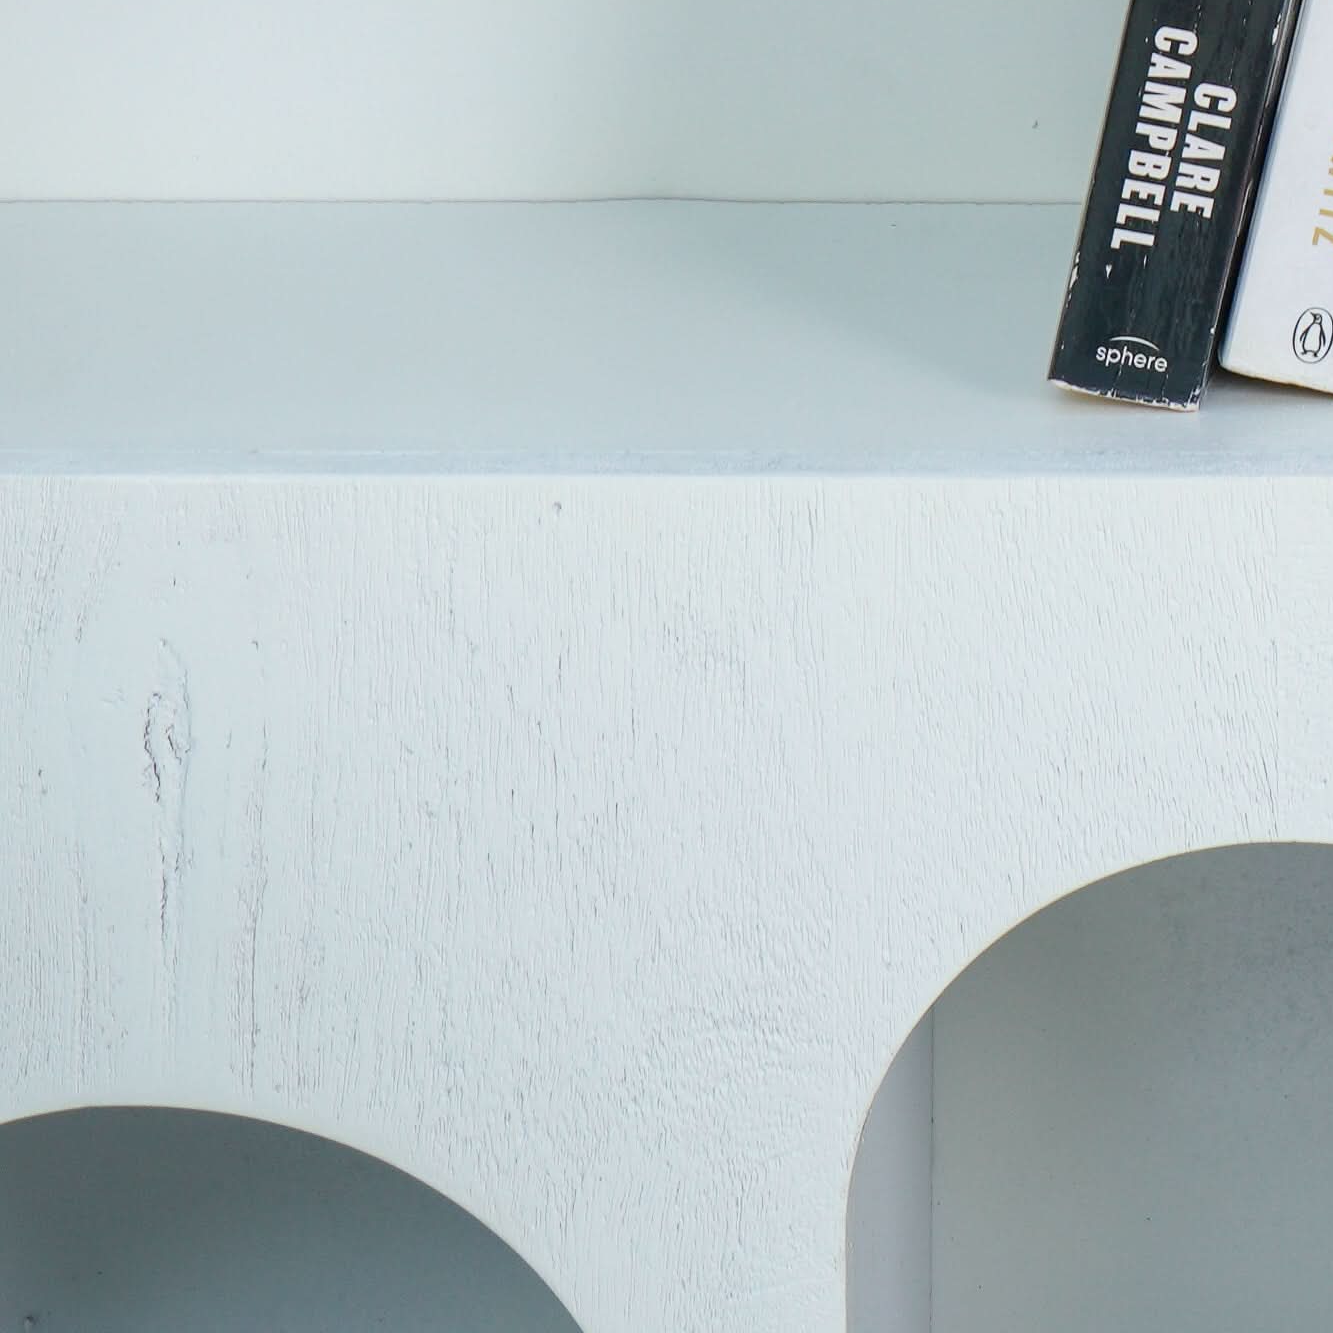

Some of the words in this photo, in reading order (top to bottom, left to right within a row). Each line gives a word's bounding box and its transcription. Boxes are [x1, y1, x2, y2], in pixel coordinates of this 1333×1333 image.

[1110, 24, 1200, 252] CAMPBELL
[1171, 81, 1238, 220] CLARE
[1095, 344, 1168, 374] sphere
